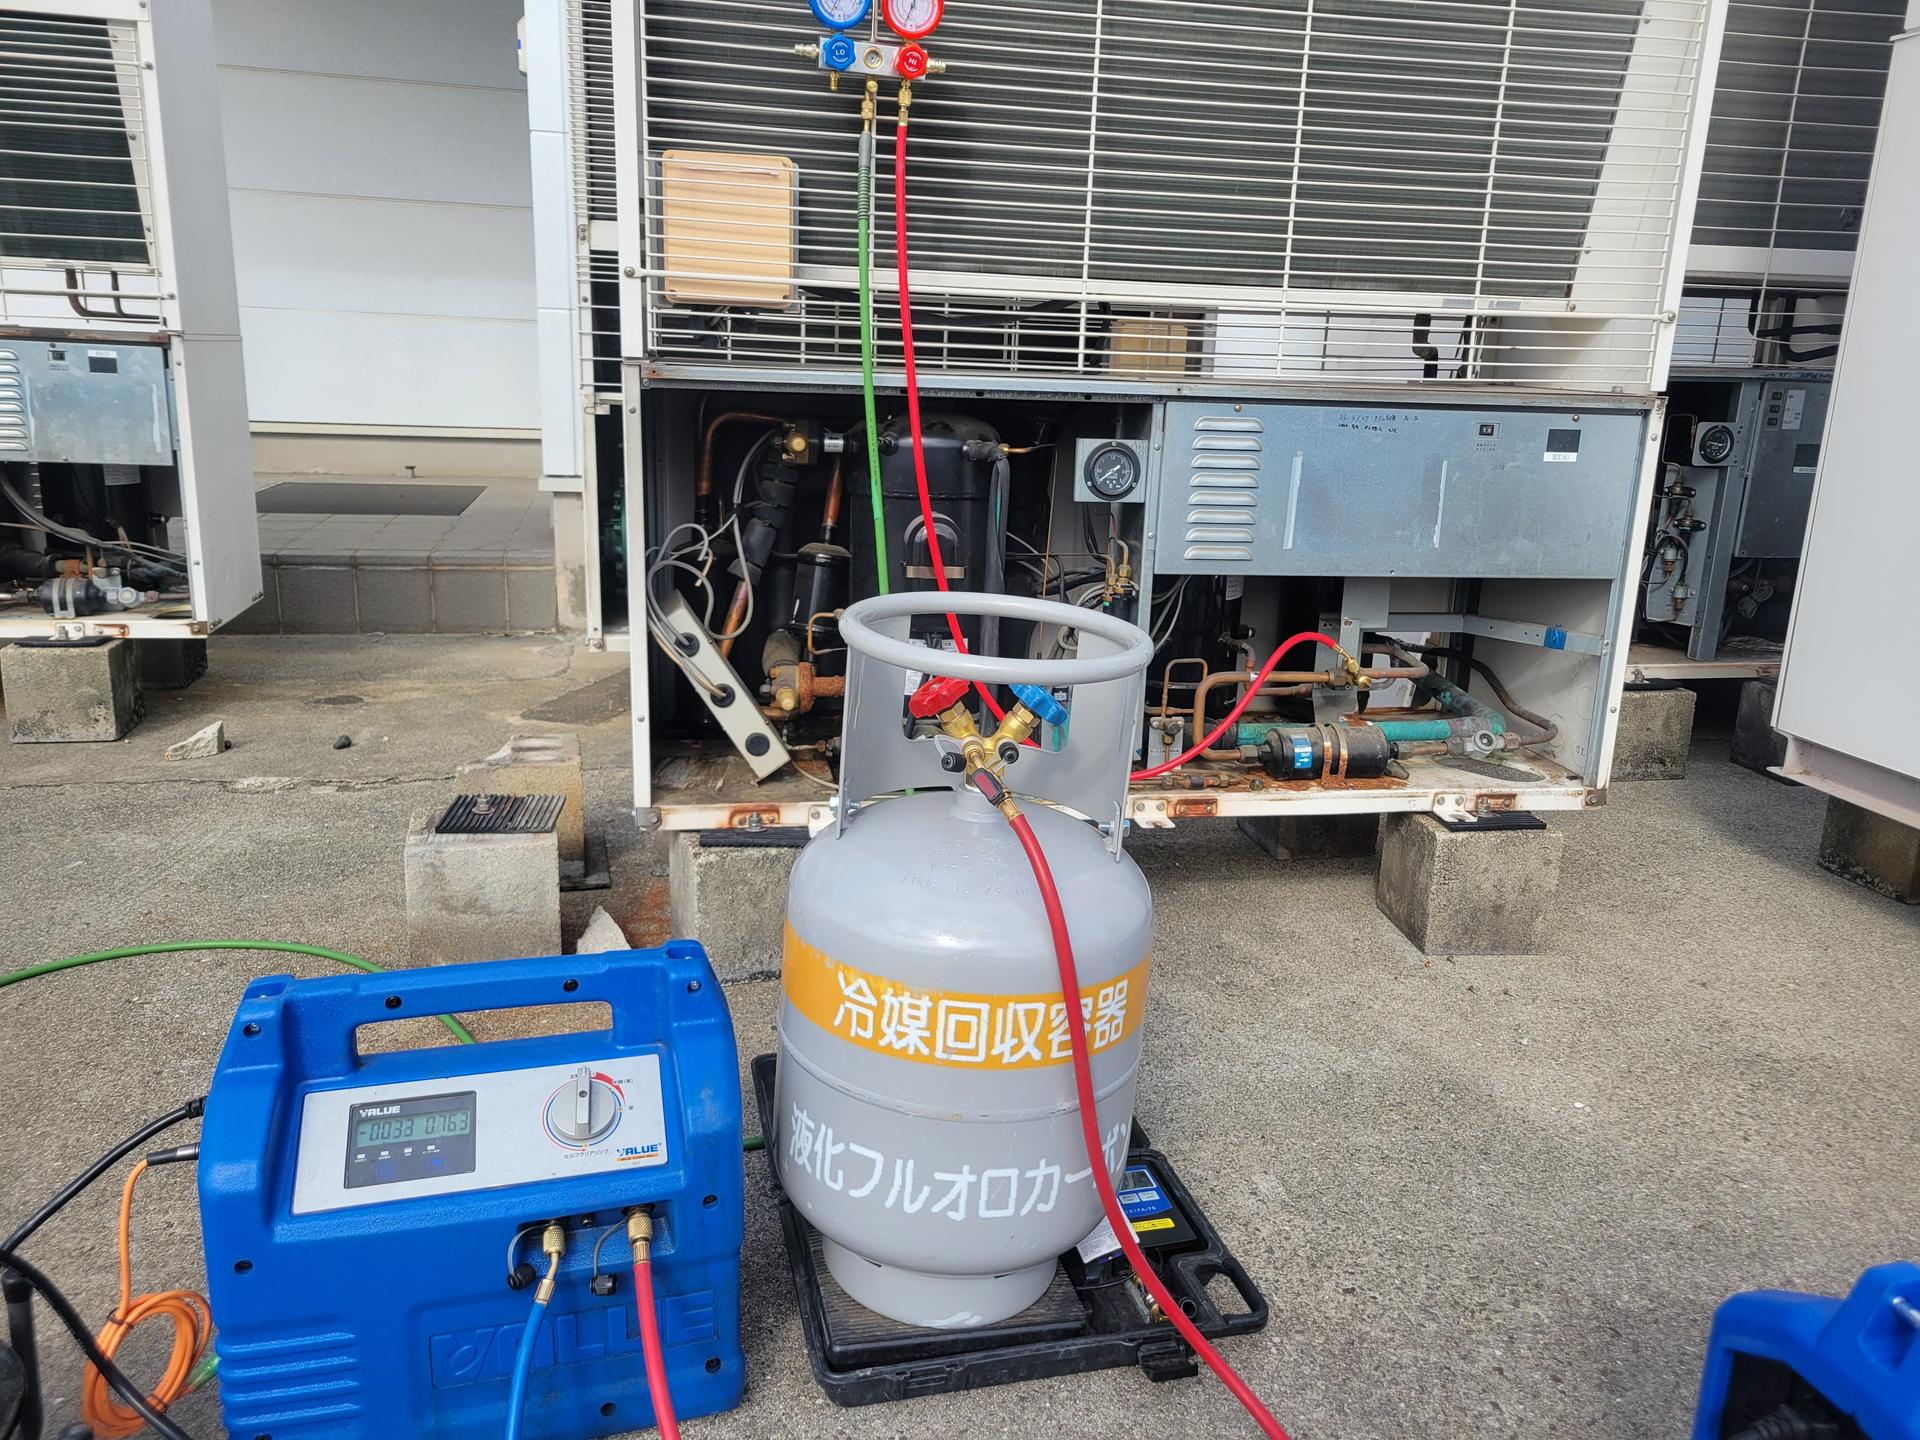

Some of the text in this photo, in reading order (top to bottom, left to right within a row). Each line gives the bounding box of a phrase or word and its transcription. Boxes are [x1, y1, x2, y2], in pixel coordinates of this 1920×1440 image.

[834, 971, 1128, 1065] 冷媒回収容器
[359, 1105, 400, 1117] VALUE
[616, 1144, 658, 1156] VALUE
